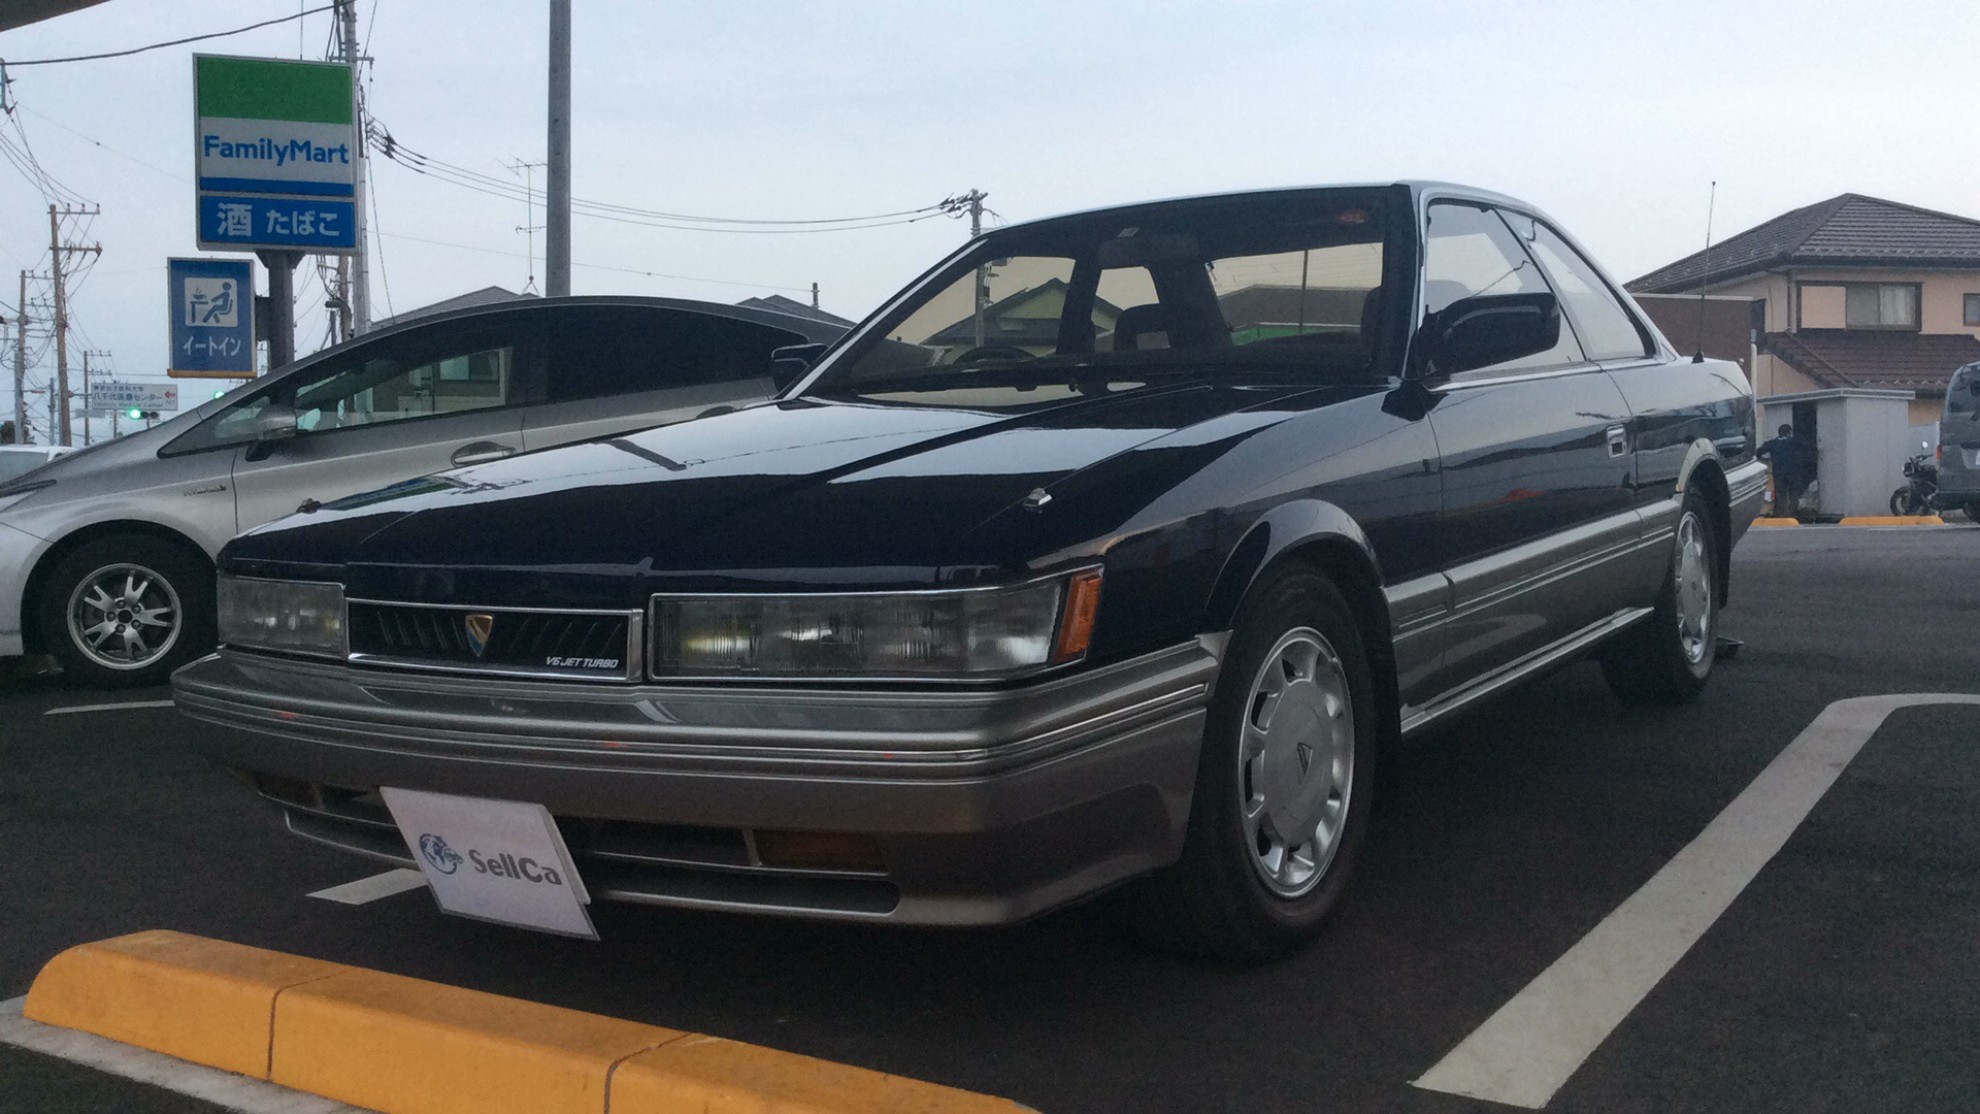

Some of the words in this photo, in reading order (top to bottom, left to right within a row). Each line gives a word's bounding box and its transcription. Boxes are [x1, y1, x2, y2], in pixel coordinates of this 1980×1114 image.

[203, 135, 350, 166] FamilyMart
[217, 203, 252, 237] 酒
[266, 208, 340, 236] たばこ
[183, 335, 241, 357] イートイン
[546, 656, 562, 666] V6
[560, 657, 583, 667] JET
[582, 658, 619, 668] TURBO
[468, 849, 563, 885] SellCa
